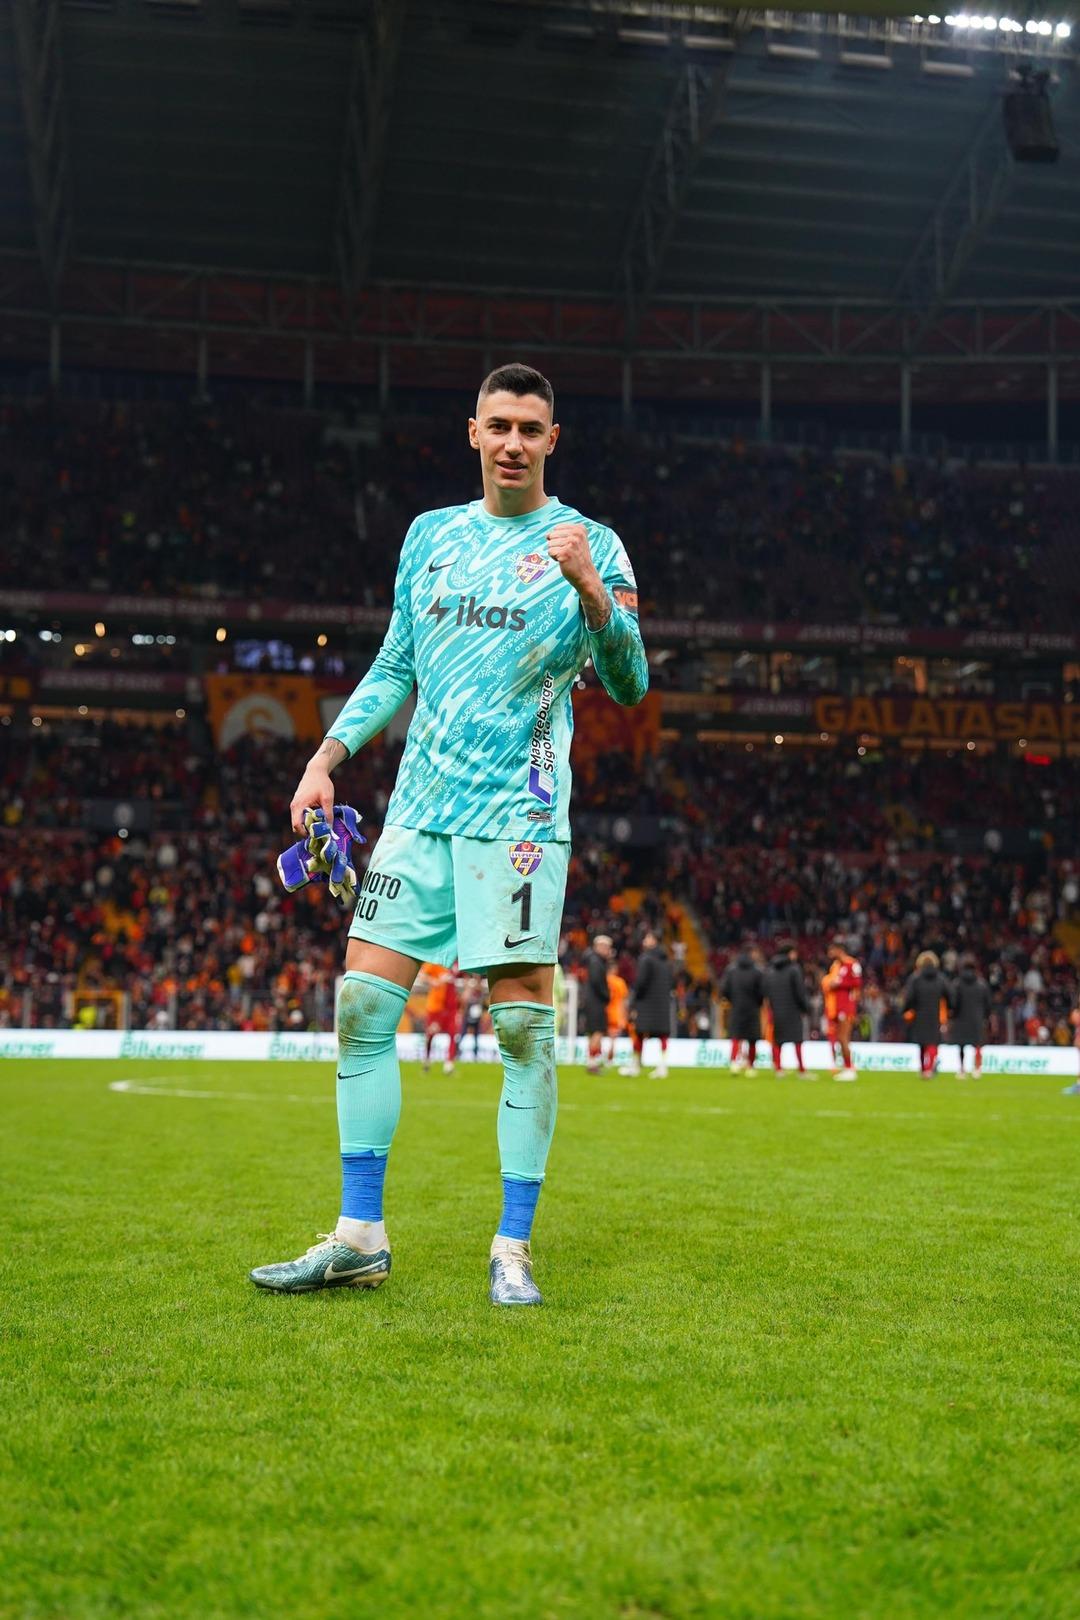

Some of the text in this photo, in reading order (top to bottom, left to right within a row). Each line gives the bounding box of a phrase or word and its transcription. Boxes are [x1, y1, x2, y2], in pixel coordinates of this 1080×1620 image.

[456, 595, 527, 632] ikas
[530, 672, 554, 767] Magdeburger
[355, 896, 379, 921] İLO
[511, 882, 532, 931] 1
